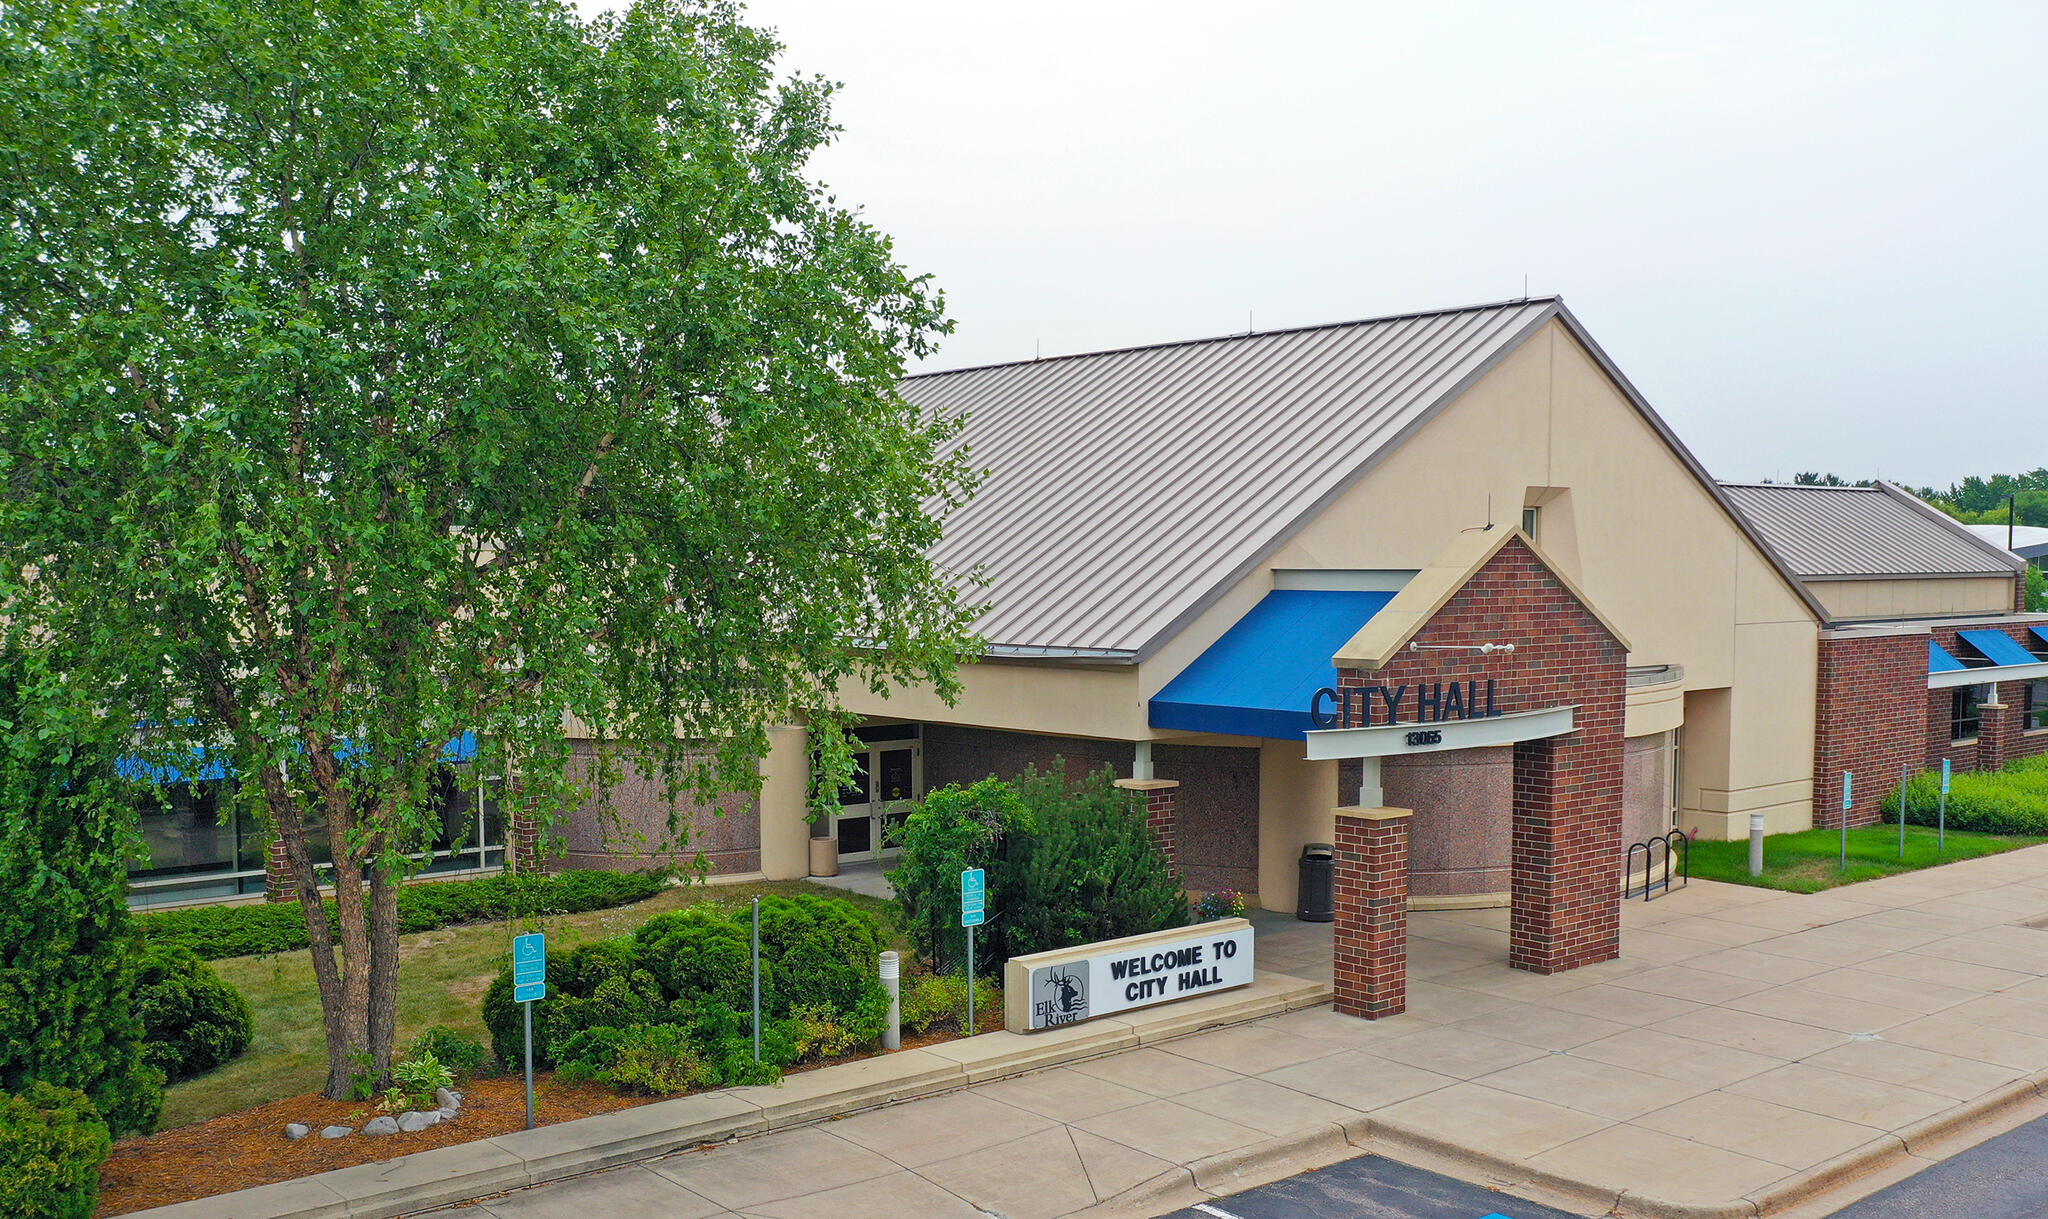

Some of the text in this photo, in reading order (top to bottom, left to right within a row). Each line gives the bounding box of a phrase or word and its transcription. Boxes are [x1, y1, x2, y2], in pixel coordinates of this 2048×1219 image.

[1311, 679, 1503, 729] CITY HALL
[1405, 730, 1442, 746] 13065
[1110, 939, 1237, 980] WELCOME TO
[1125, 966, 1223, 1002] CITY HALL
[1035, 1000, 1056, 1016] Elk
[1045, 1011, 1078, 1027] River
